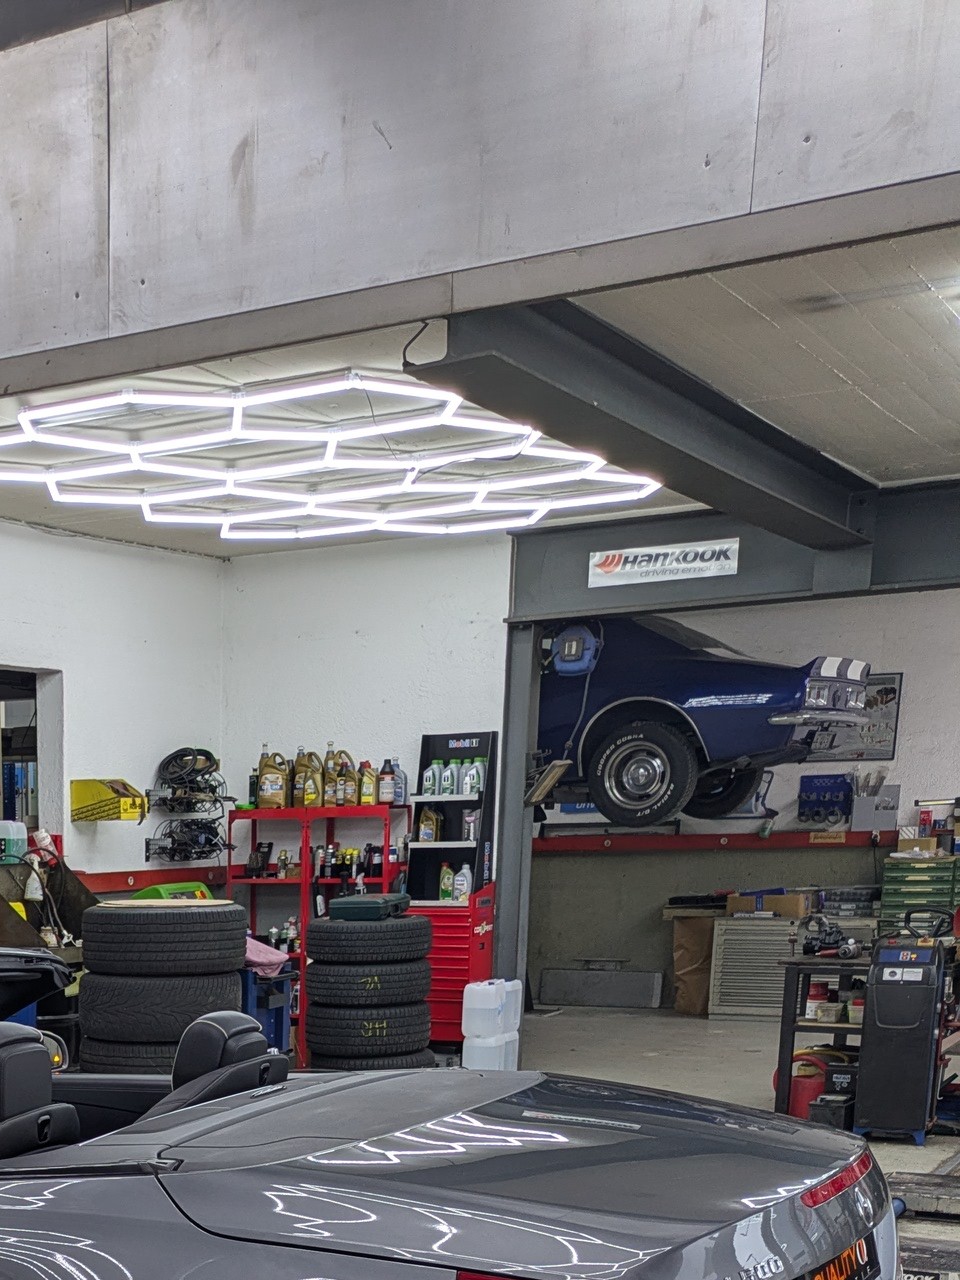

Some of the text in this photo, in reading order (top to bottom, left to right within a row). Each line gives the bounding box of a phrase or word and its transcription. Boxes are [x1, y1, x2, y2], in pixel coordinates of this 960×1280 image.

[640, 562, 732, 578] driving emotion
[448, 739, 470, 749] Mobil
